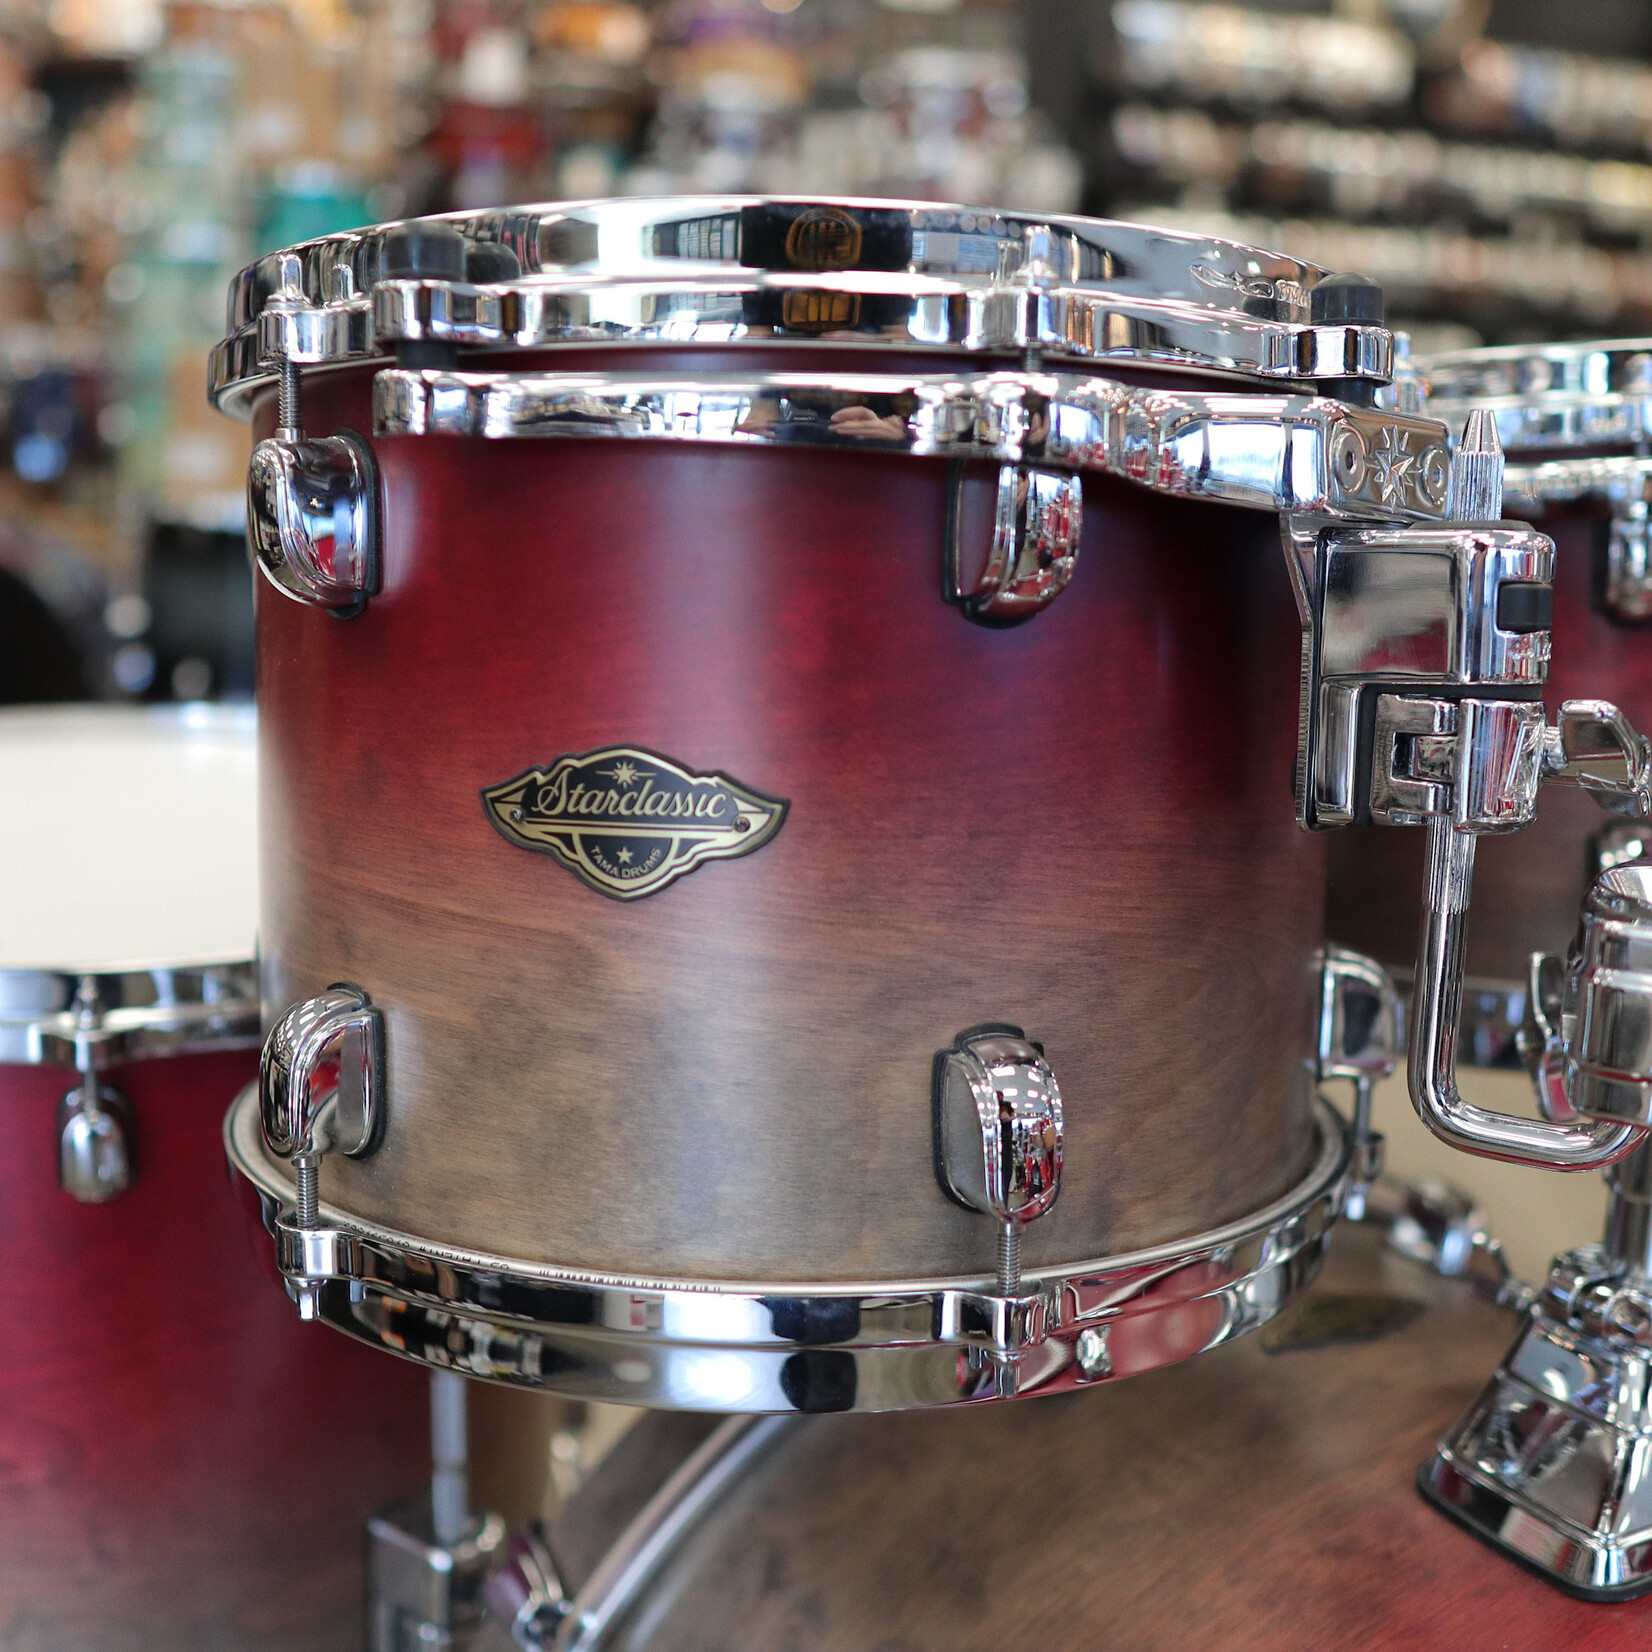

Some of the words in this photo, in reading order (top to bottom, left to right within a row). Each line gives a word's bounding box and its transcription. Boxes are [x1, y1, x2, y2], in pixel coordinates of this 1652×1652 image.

[531, 767, 727, 818] Starclassic
[590, 845, 619, 877] TAMA
[621, 847, 662, 878] DRUMS
